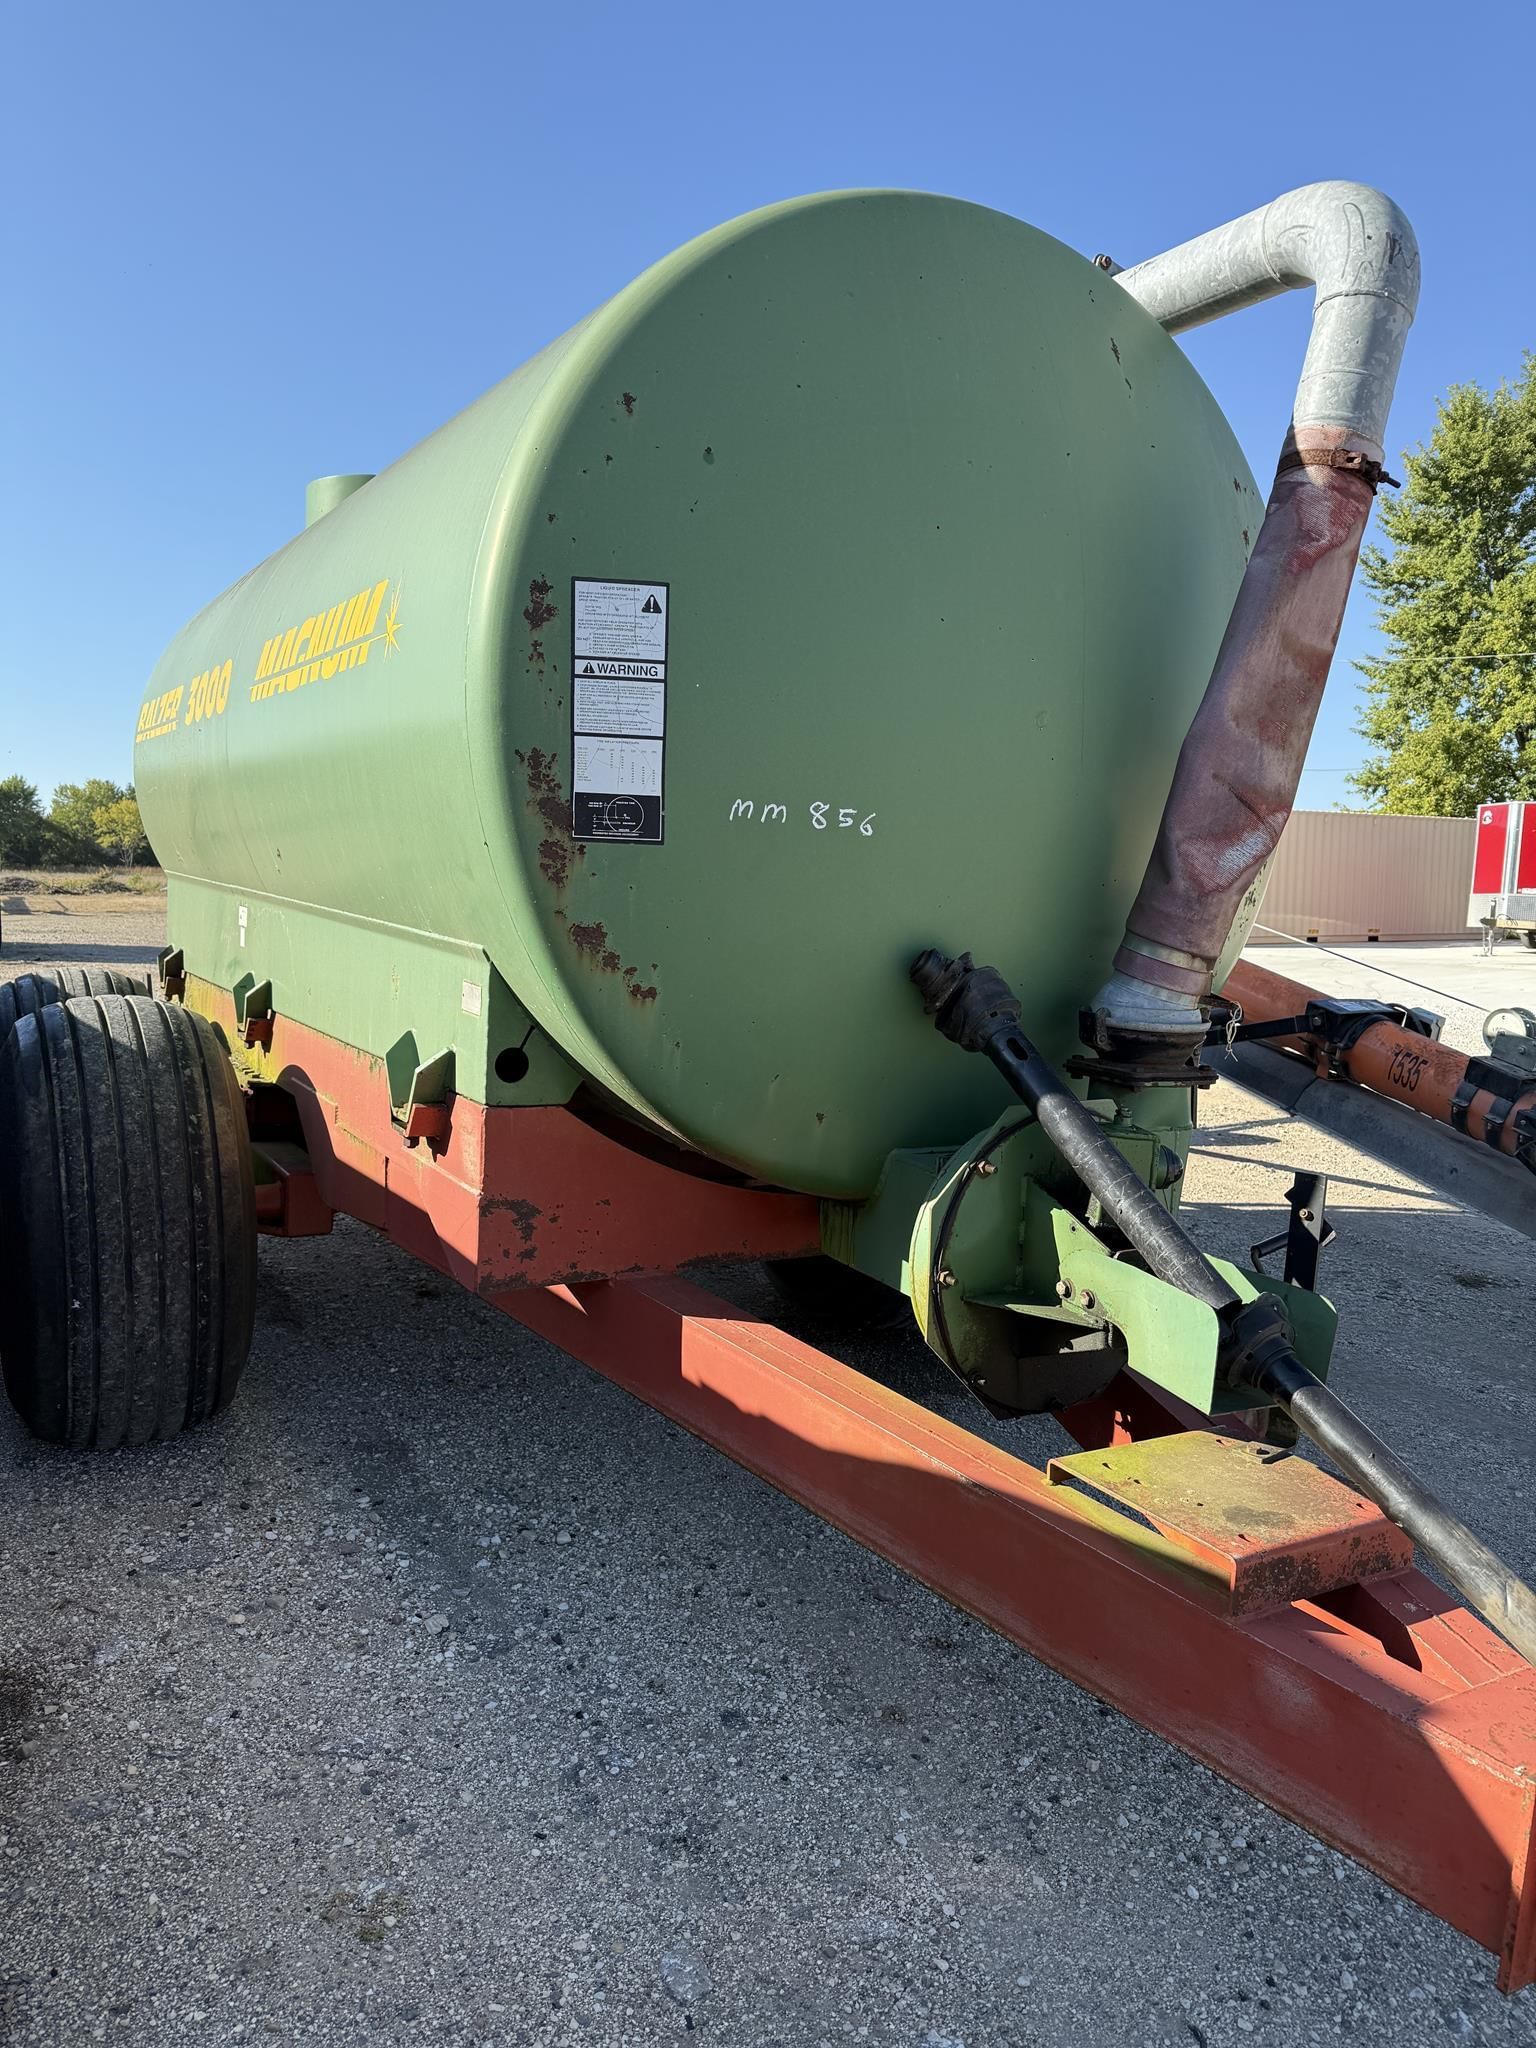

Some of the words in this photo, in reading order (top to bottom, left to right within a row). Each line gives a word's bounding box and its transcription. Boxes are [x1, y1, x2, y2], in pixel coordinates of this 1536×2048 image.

[184, 658, 233, 726] 3000
[249, 578, 389, 703] MAGNUM
[597, 662, 659, 677] WARNING
[809, 801, 876, 836] 856
